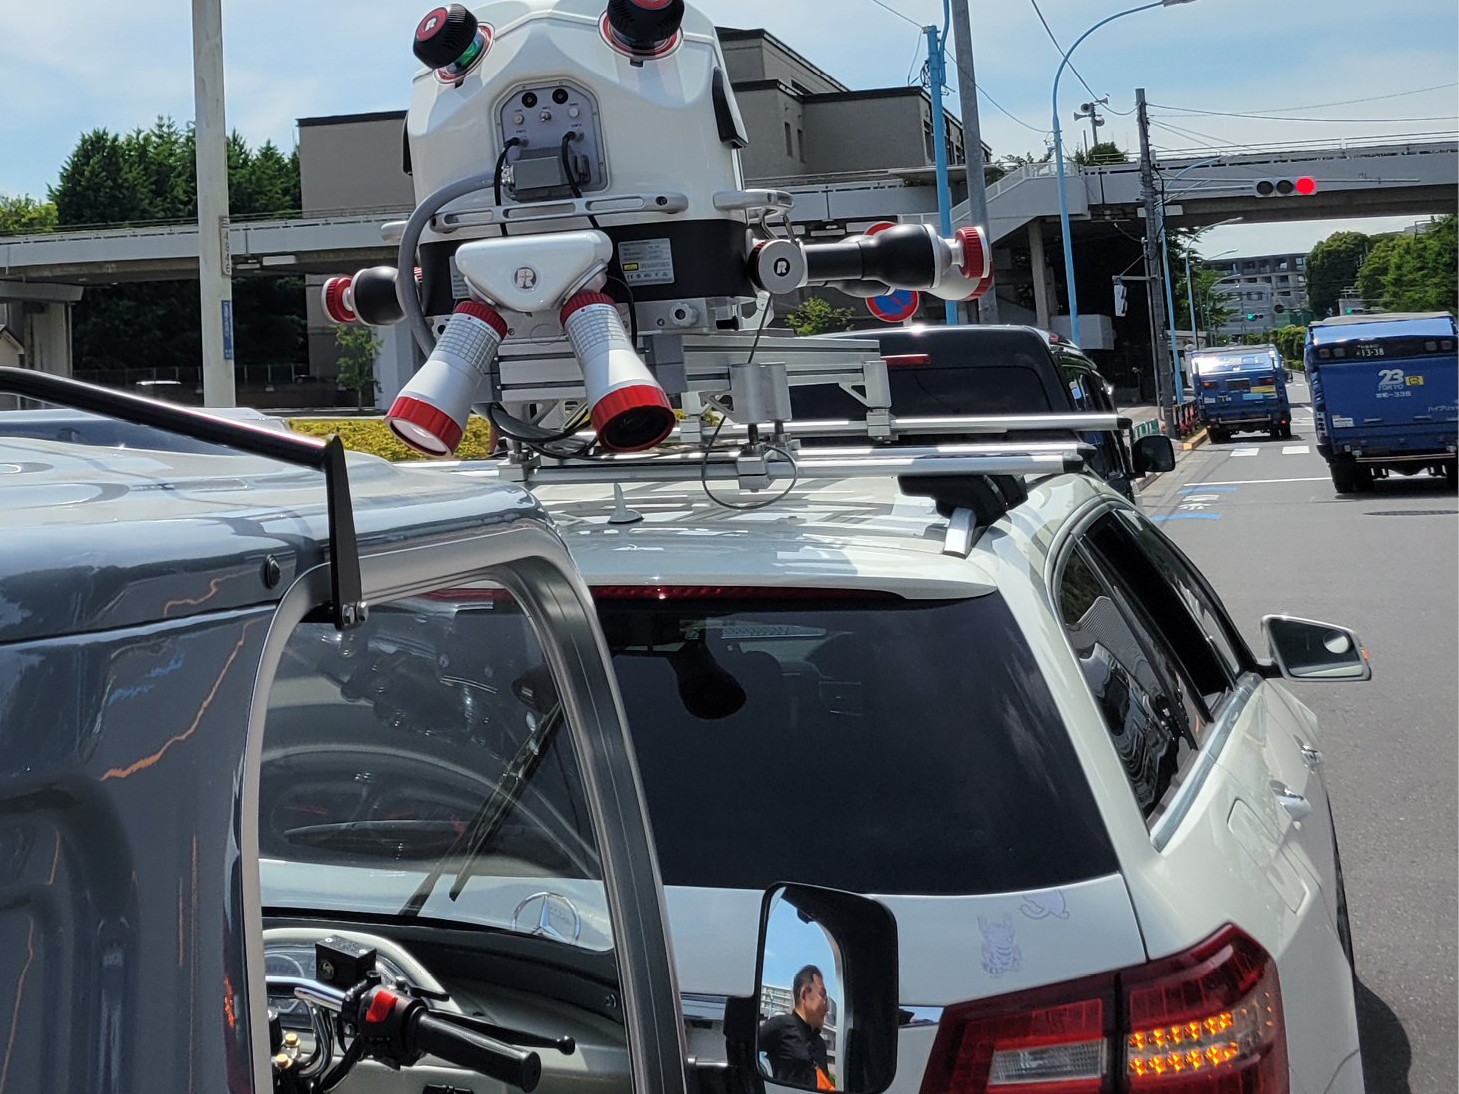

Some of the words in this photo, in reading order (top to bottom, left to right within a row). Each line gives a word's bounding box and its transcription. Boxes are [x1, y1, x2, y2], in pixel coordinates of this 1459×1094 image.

[776, 261, 788, 274] R
[1378, 369, 1404, 386] 23
[1378, 384, 1404, 392] TOKYO
